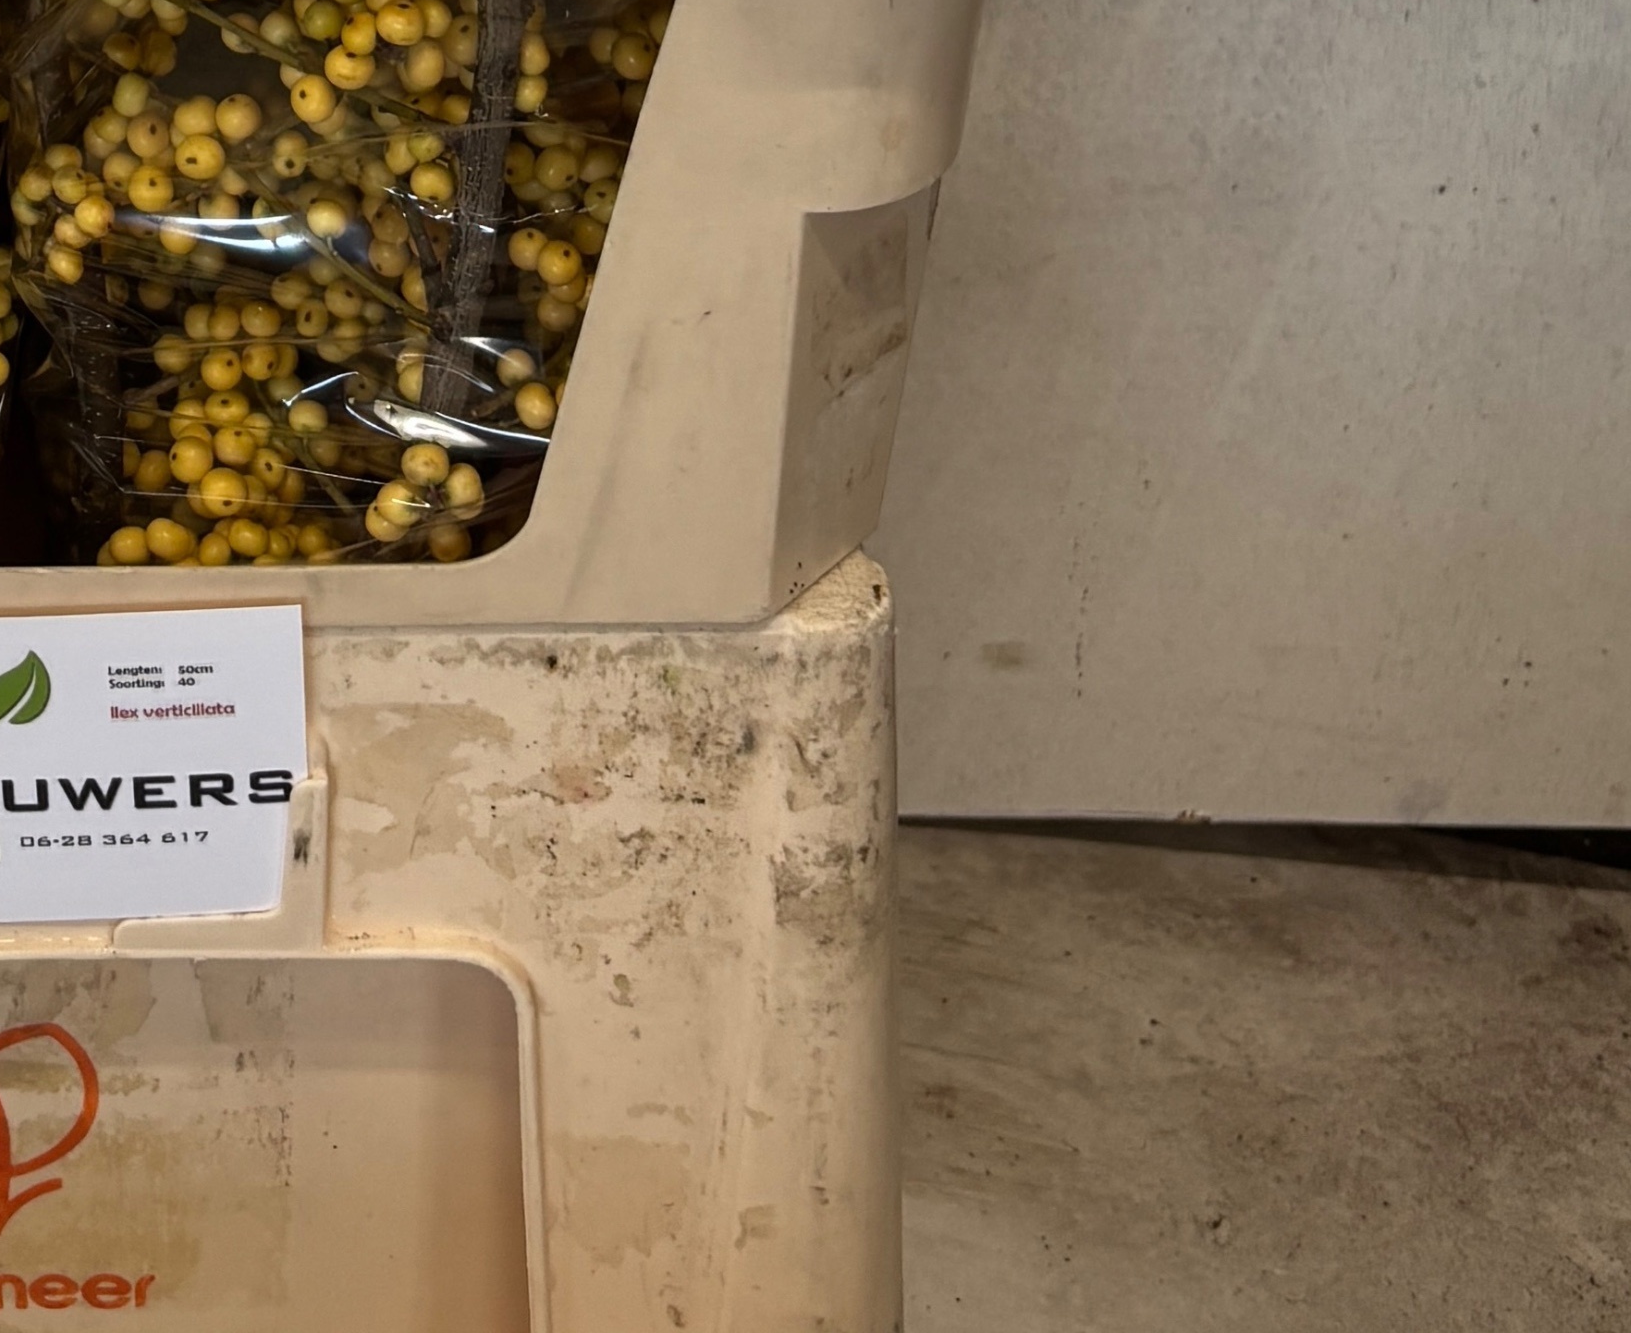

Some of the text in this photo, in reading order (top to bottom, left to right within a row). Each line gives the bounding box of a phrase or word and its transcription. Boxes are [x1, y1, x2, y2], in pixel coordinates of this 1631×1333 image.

[178, 665, 214, 674] 50cm
[109, 677, 196, 689] Soorting: 40
[111, 702, 235, 719] Ilex verticillata
[20, 831, 209, 847] 06-28 364 617
